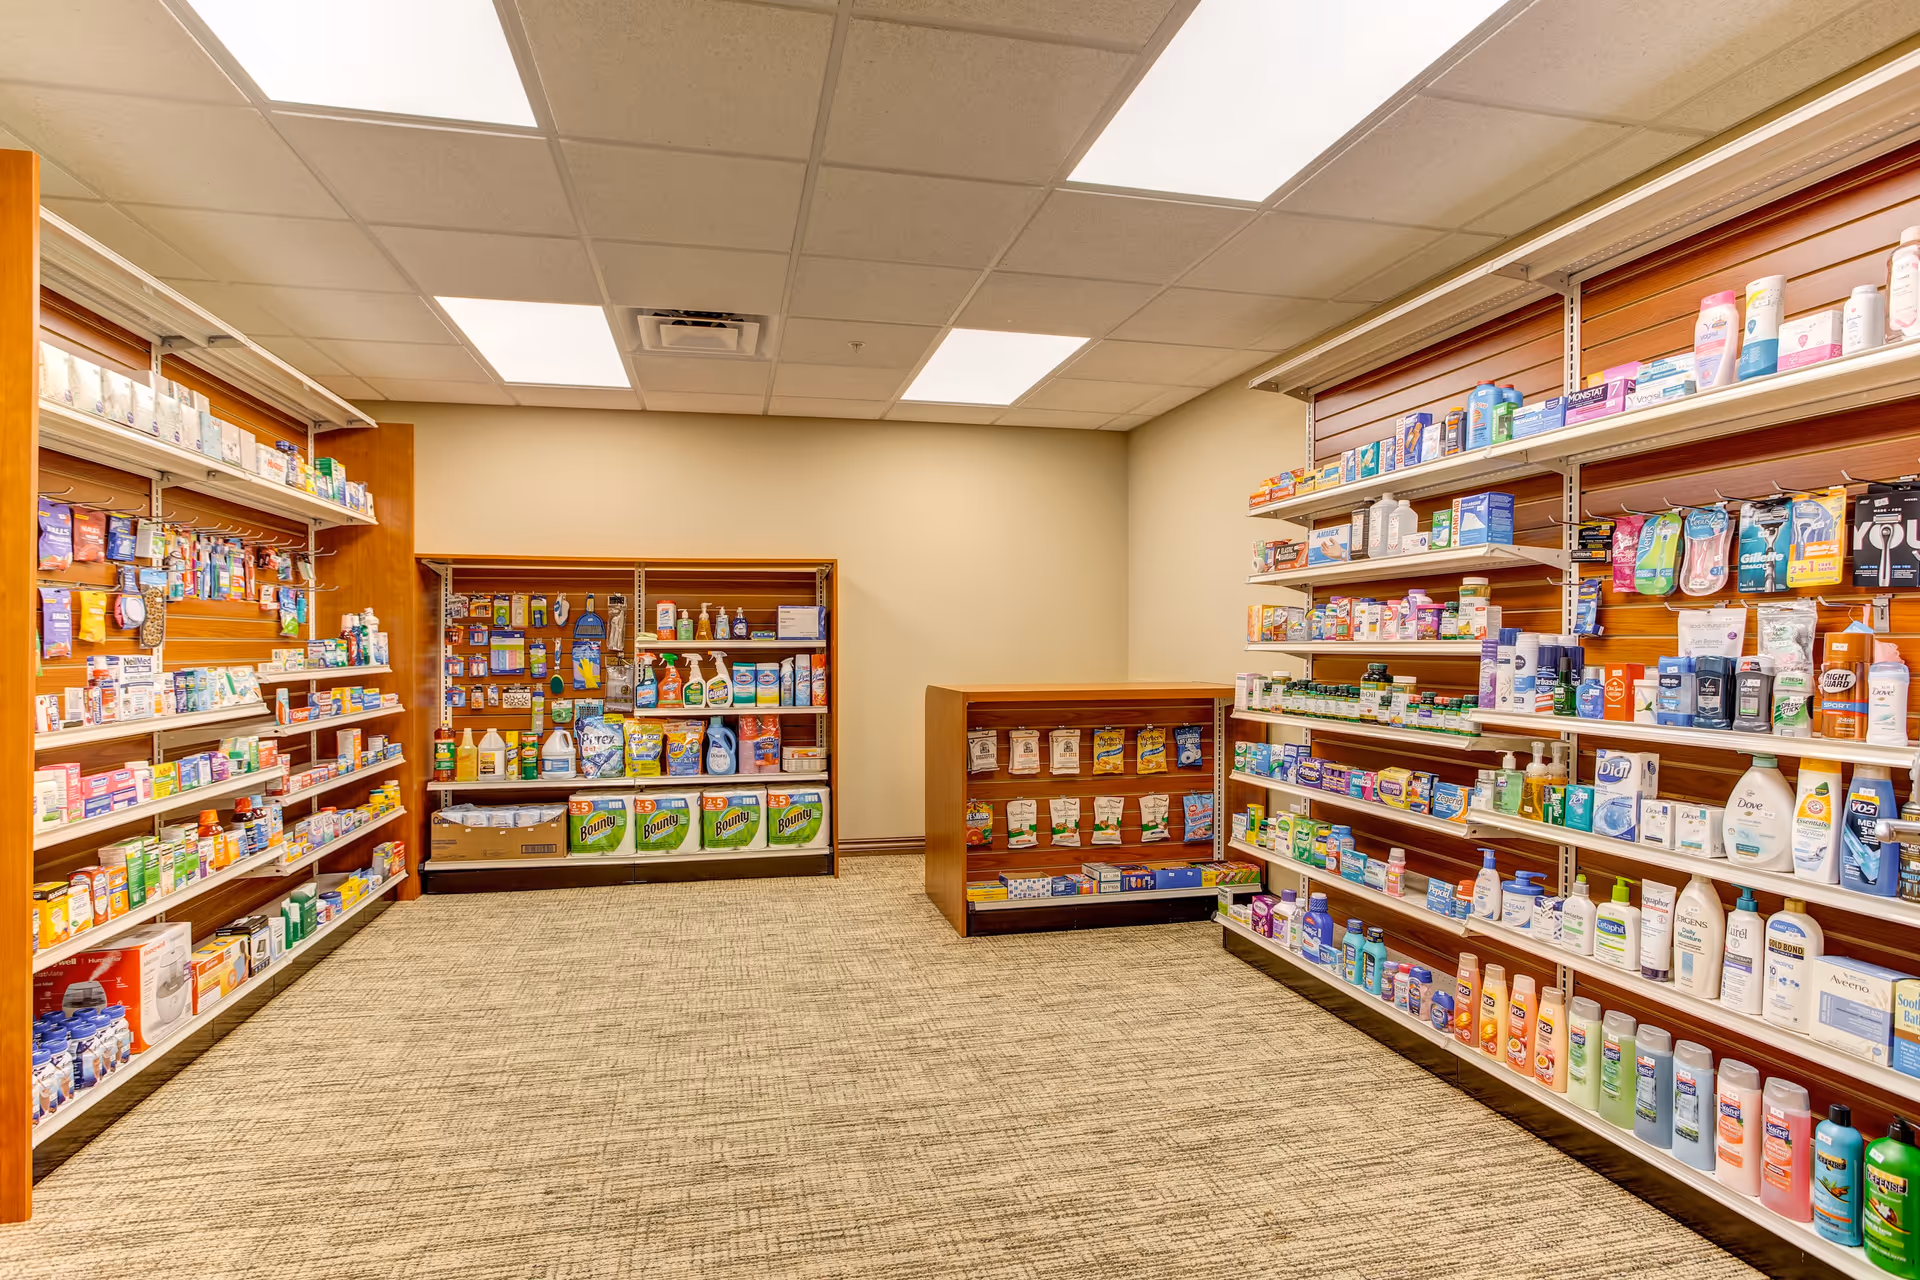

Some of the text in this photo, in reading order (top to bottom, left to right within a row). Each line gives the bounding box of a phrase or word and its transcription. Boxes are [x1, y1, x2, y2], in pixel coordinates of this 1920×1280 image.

[1568, 386, 1604, 403] MONISTAT
[1317, 529, 1339, 539] AMMEX
[124, 656, 151, 667] NeilMed
[1825, 672, 1851, 681] RIGHT
[1646, 806, 1662, 815] Dove
[1737, 797, 1763, 810] Dove
[1852, 800, 1876, 814] VO5
[778, 808, 812, 834] Bounty
[1681, 811, 1699, 820] Dove
[580, 815, 616, 842] Bounty
[643, 814, 679, 840] Bounty
[715, 810, 750, 838] Bounty
[1597, 919, 1625, 934] Cetaphil
[1682, 926, 1696, 936] Daily
[1769, 938, 1804, 955] GOLD BOND
[1830, 974, 1869, 993] Aveeno
[1720, 1102, 1740, 1117] Suave
[1766, 1122, 1789, 1138] Suave
[1867, 1170, 1904, 1195] DEFENSE
